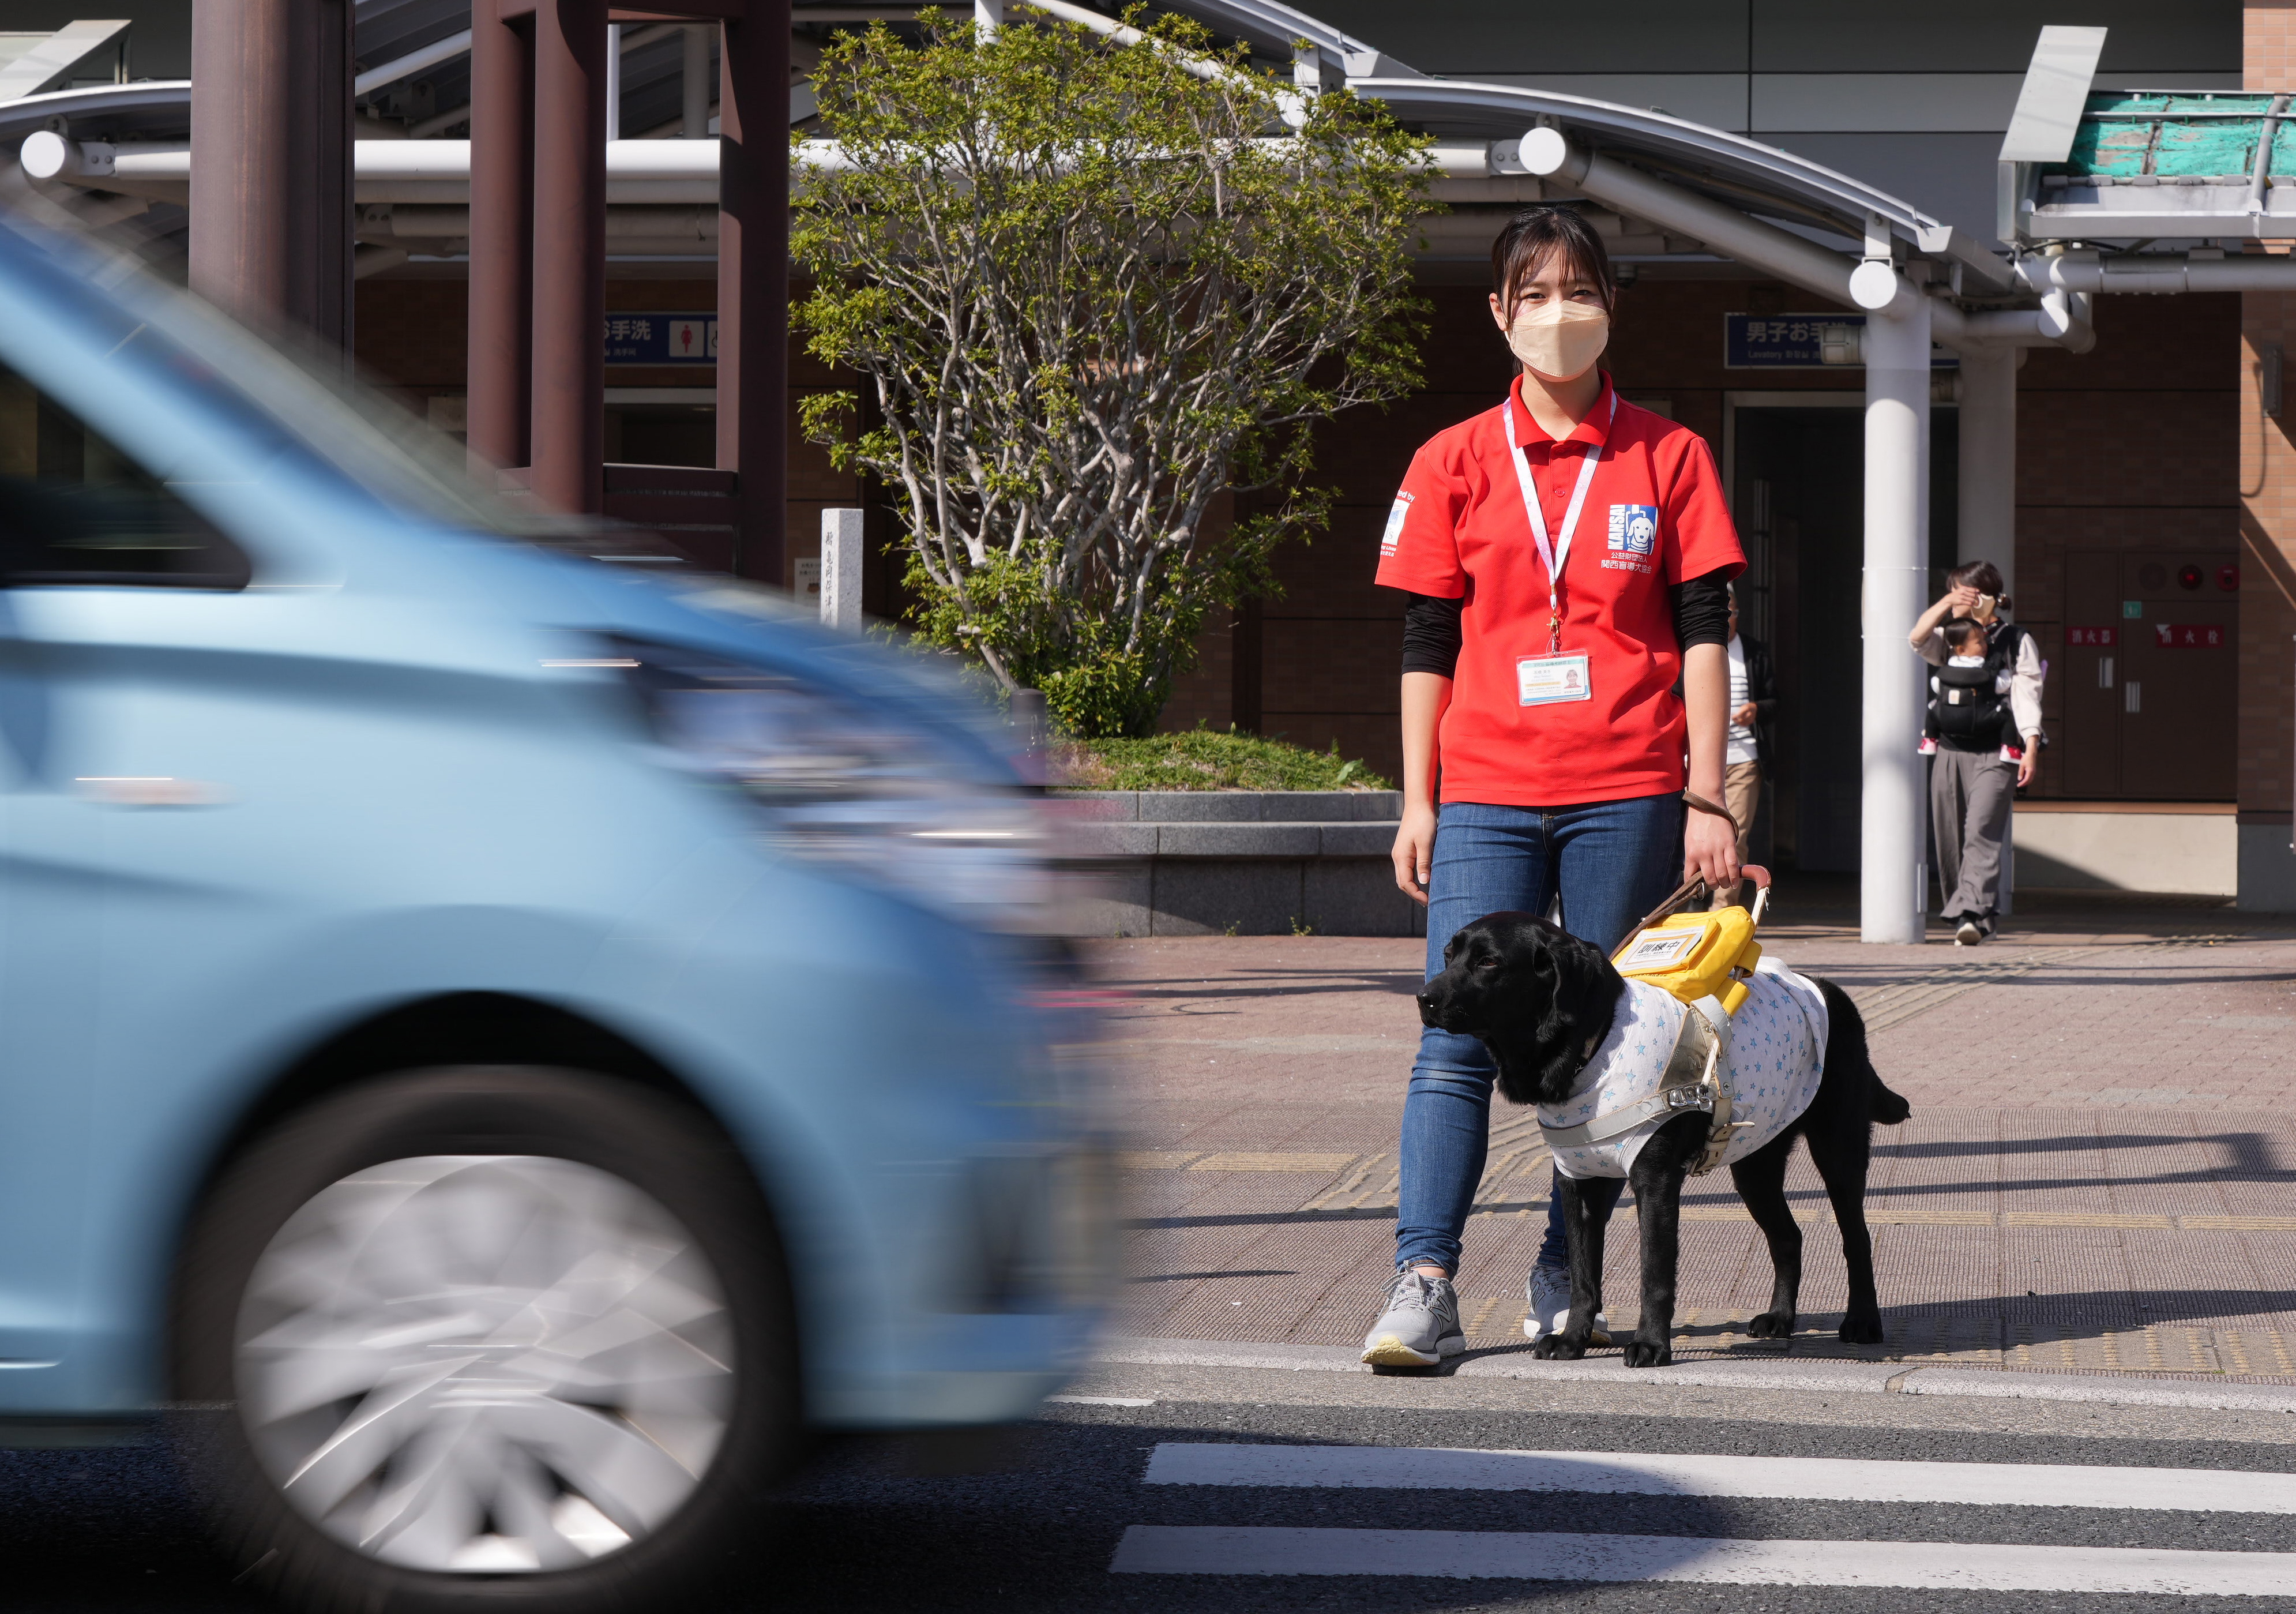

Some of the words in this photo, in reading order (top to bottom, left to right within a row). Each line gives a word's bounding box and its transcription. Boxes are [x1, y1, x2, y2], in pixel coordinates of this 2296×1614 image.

[1747, 321, 1845, 343] 男子お手
[1748, 350, 1783, 360] Lavatory
[1407, 492, 1415, 503] by
[1607, 504, 1626, 550] KANSAI
[1611, 551, 1648, 564] 公益財団法人
[1601, 560, 1652, 574] 関西盲導犬協会
[2072, 629, 2111, 644] 消火器
[2163, 629, 2219, 644] 消火栓
[1637, 940, 1681, 954] 訓練中
